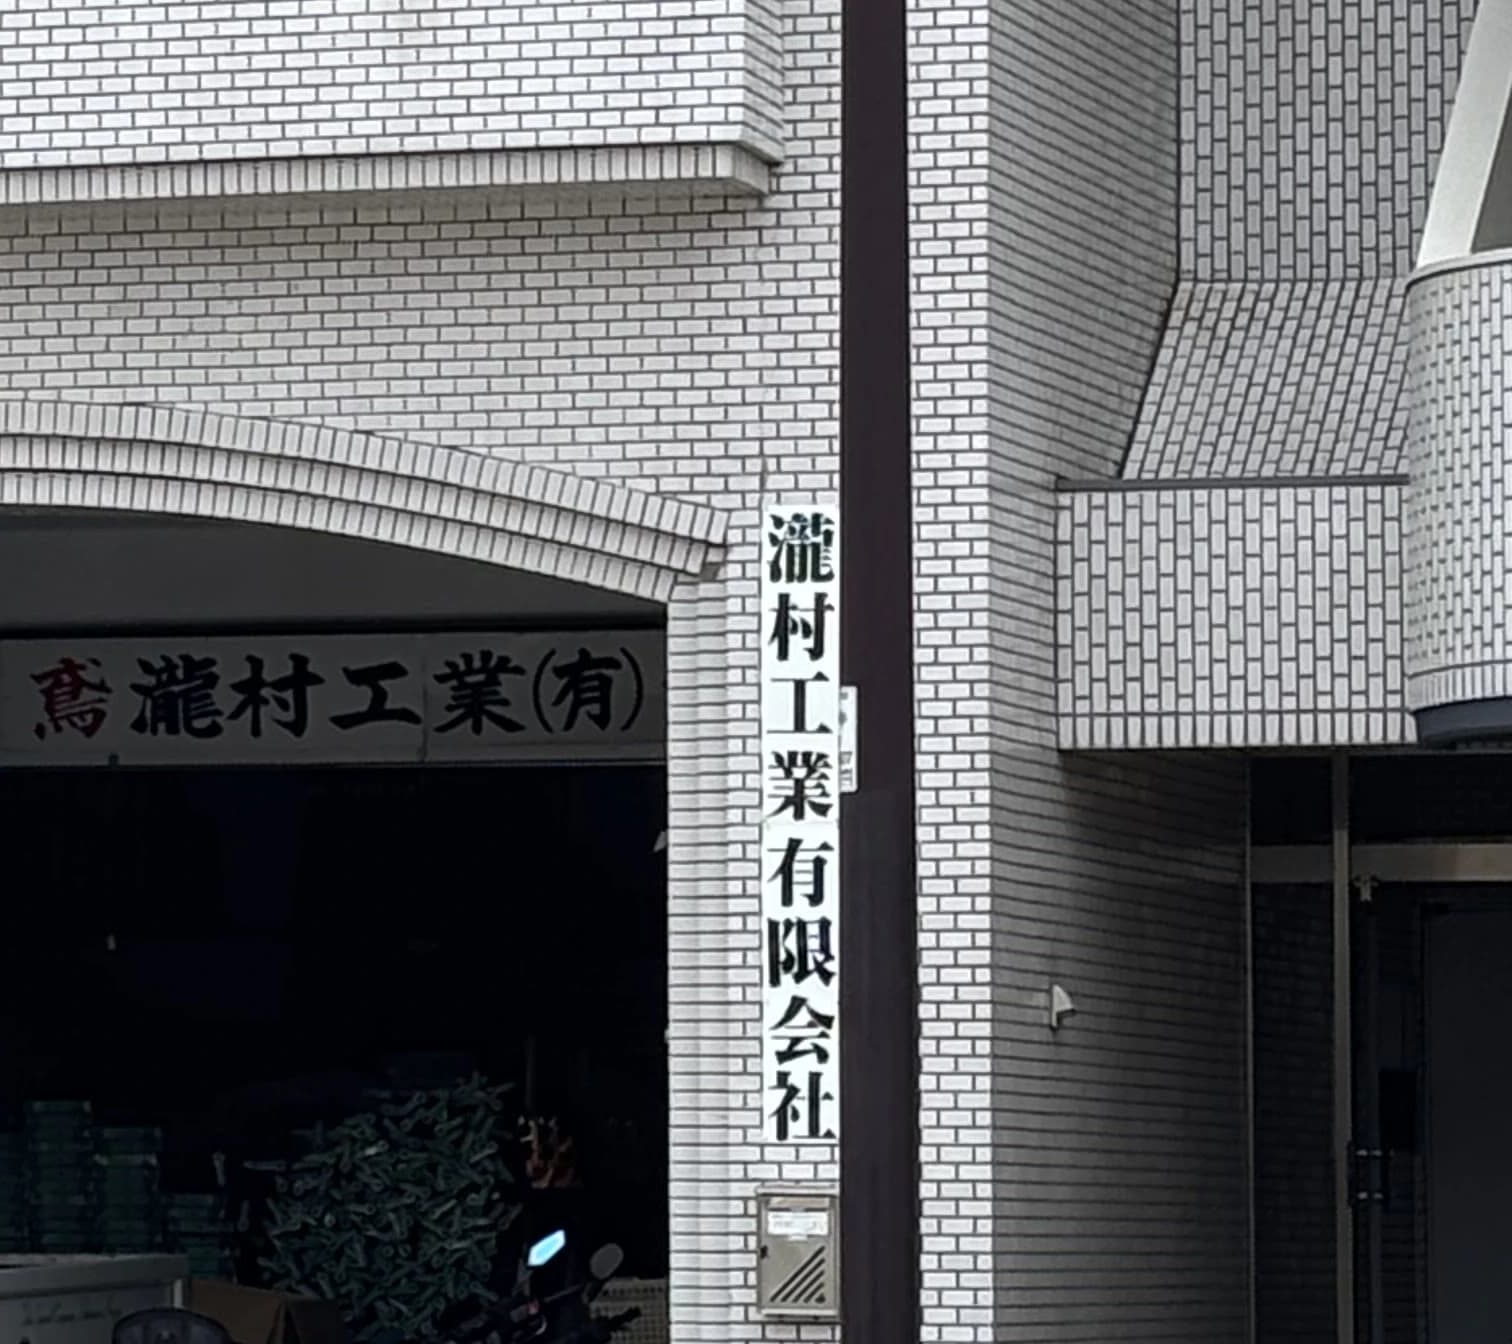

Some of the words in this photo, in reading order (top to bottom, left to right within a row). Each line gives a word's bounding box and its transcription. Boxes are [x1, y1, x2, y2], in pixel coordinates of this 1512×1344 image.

[765, 511, 837, 1142] 瀧村工業有限会社
